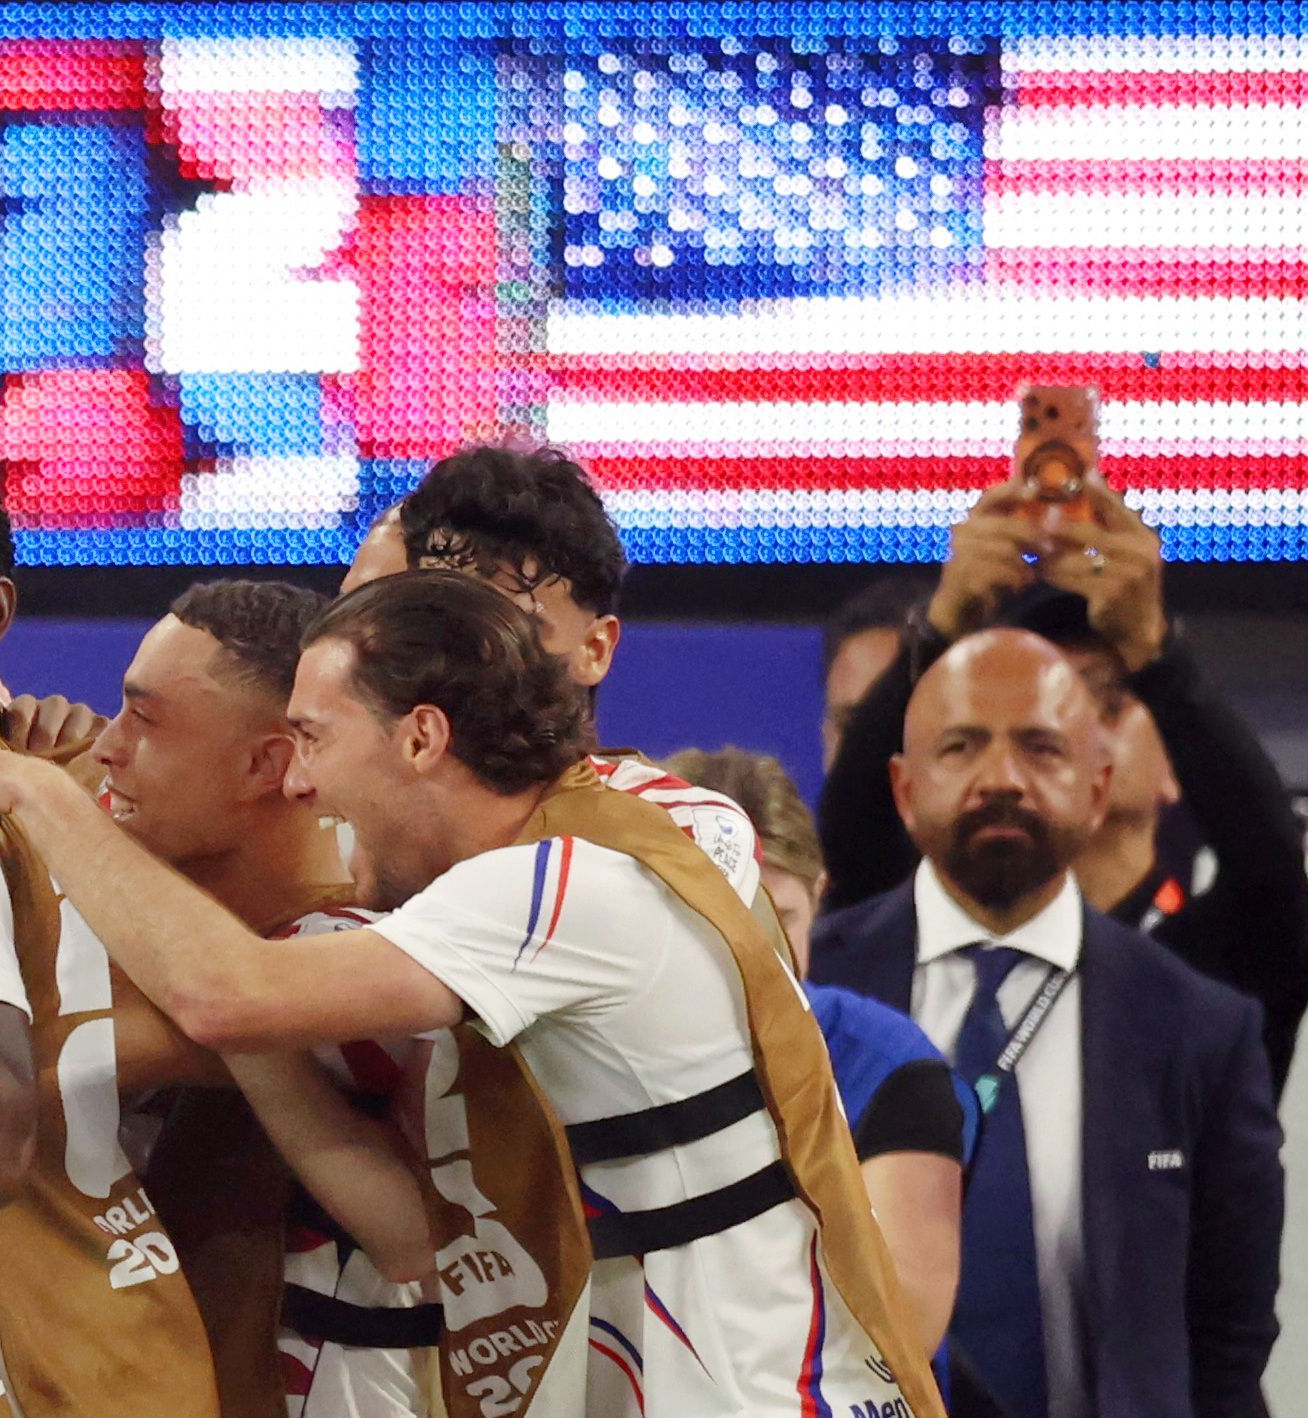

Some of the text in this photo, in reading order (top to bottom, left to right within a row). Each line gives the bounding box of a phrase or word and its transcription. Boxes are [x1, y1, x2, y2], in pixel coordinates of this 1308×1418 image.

[997, 1041, 1024, 1072] FIFA
[1148, 1151, 1183, 1170] FIFA
[439, 1249, 516, 1297] FIFA
